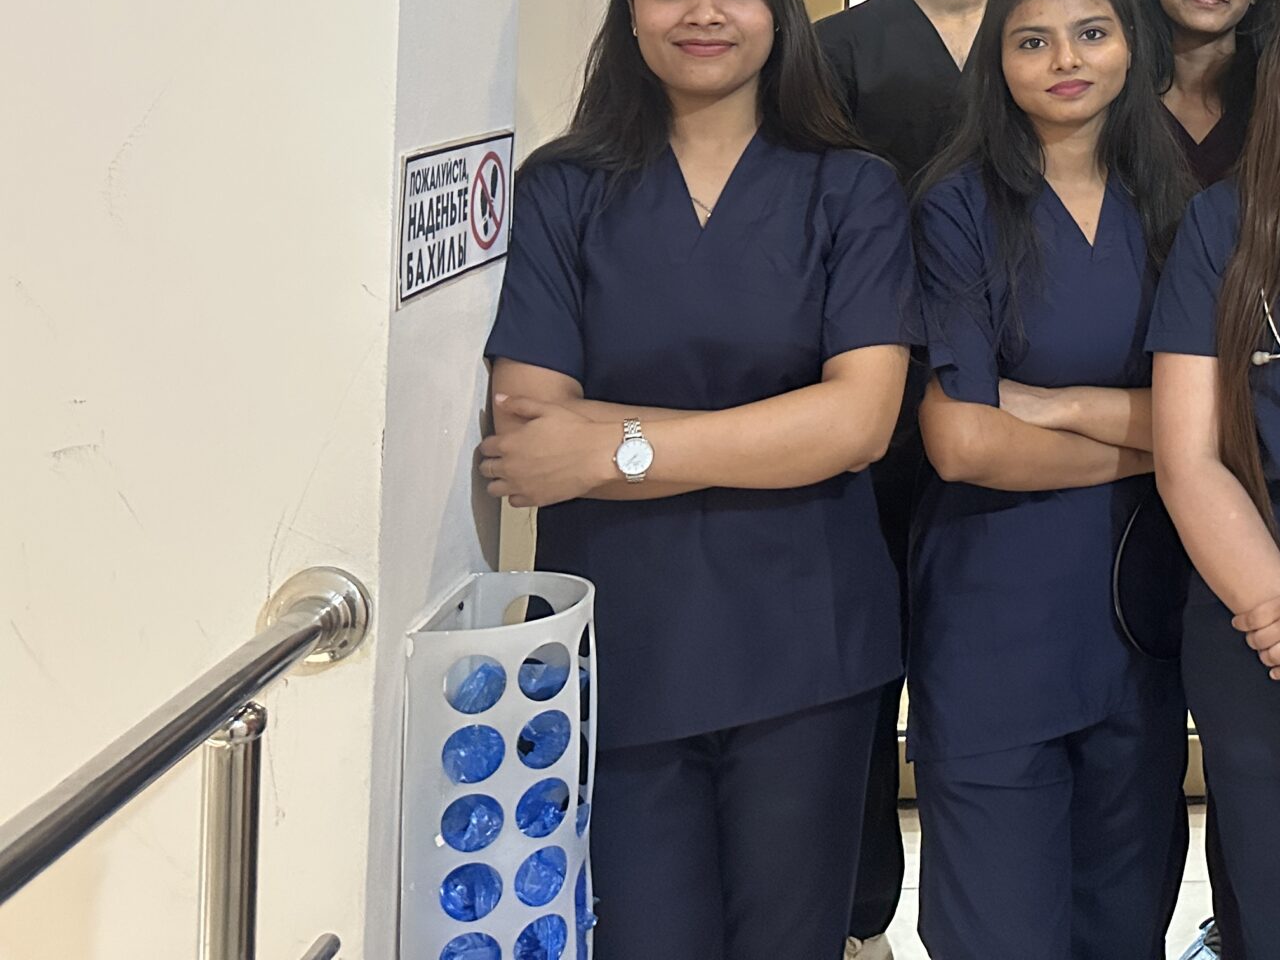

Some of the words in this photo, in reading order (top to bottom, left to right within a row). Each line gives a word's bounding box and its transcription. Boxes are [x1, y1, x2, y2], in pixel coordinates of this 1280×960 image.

[409, 157, 470, 197] ПОЖАЛУЙСТА,
[407, 186, 469, 242] НАДЕНЬТЕ
[406, 231, 467, 291] БАХИЛЫ
